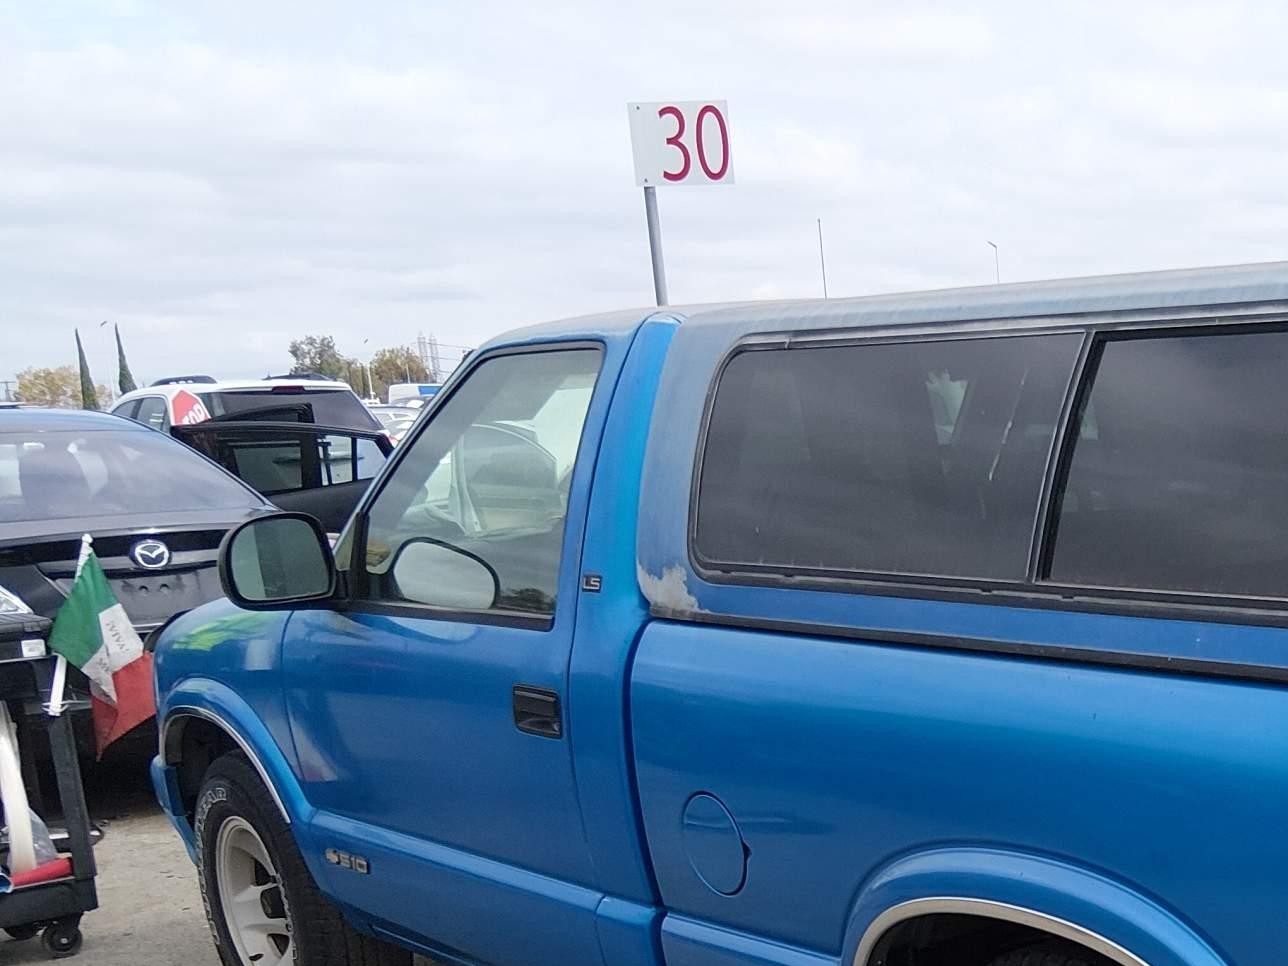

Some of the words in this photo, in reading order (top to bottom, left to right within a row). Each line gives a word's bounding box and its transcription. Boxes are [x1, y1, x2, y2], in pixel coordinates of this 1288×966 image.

[658, 105, 729, 182] 30
[583, 577, 601, 590] LS
[339, 852, 368, 874] S10
